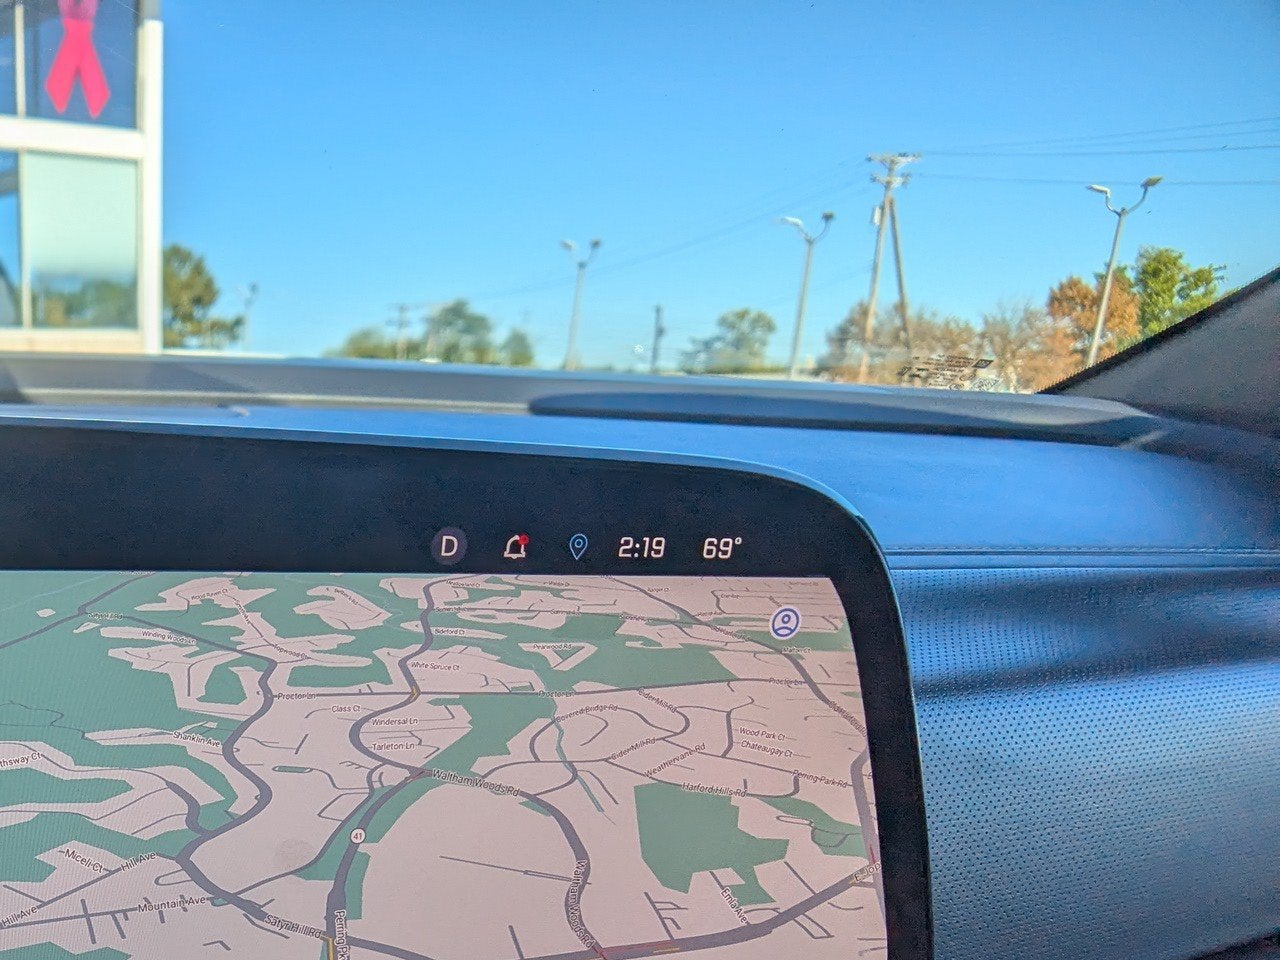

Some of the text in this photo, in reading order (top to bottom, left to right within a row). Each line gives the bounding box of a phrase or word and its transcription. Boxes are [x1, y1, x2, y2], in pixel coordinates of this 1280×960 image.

[441, 536, 458, 556] D
[618, 537, 665, 558] 2:19
[703, 537, 742, 559] 69°
[142, 631, 165, 640] Winding
[411, 661, 428, 669] White
[429, 663, 451, 671] Spruce
[609, 704, 618, 712] Rd
[372, 718, 407, 726] Windersal
[172, 731, 220, 748] Shanklin Ave
[740, 727, 759, 736] Wood
[761, 731, 777, 740] Park
[372, 743, 404, 751] Tarleton
[740, 741, 792, 757] Chateaugay Ct
[31, 752, 41, 760] Ct
[644, 743, 706, 777] Weathervane Rd
[433, 769, 520, 797] Waltham Woods Rd
[682, 782, 747, 797] Harford Hills Rd
[838, 780, 848, 788] Rd
[353, 832, 362, 840] 41
[65, 849, 104, 874] Miceli Ct
[121, 852, 157, 872] Hill Ave
[138, 896, 206, 913] Mountain Ave
[569, 859, 595, 948] Waltham Woods Rd
[1, 905, 38, 927] Hill Ave
[734, 908, 748, 924] Ave
[265, 914, 321, 938] Satyr Hill Rd
[335, 910, 347, 947] Perring
